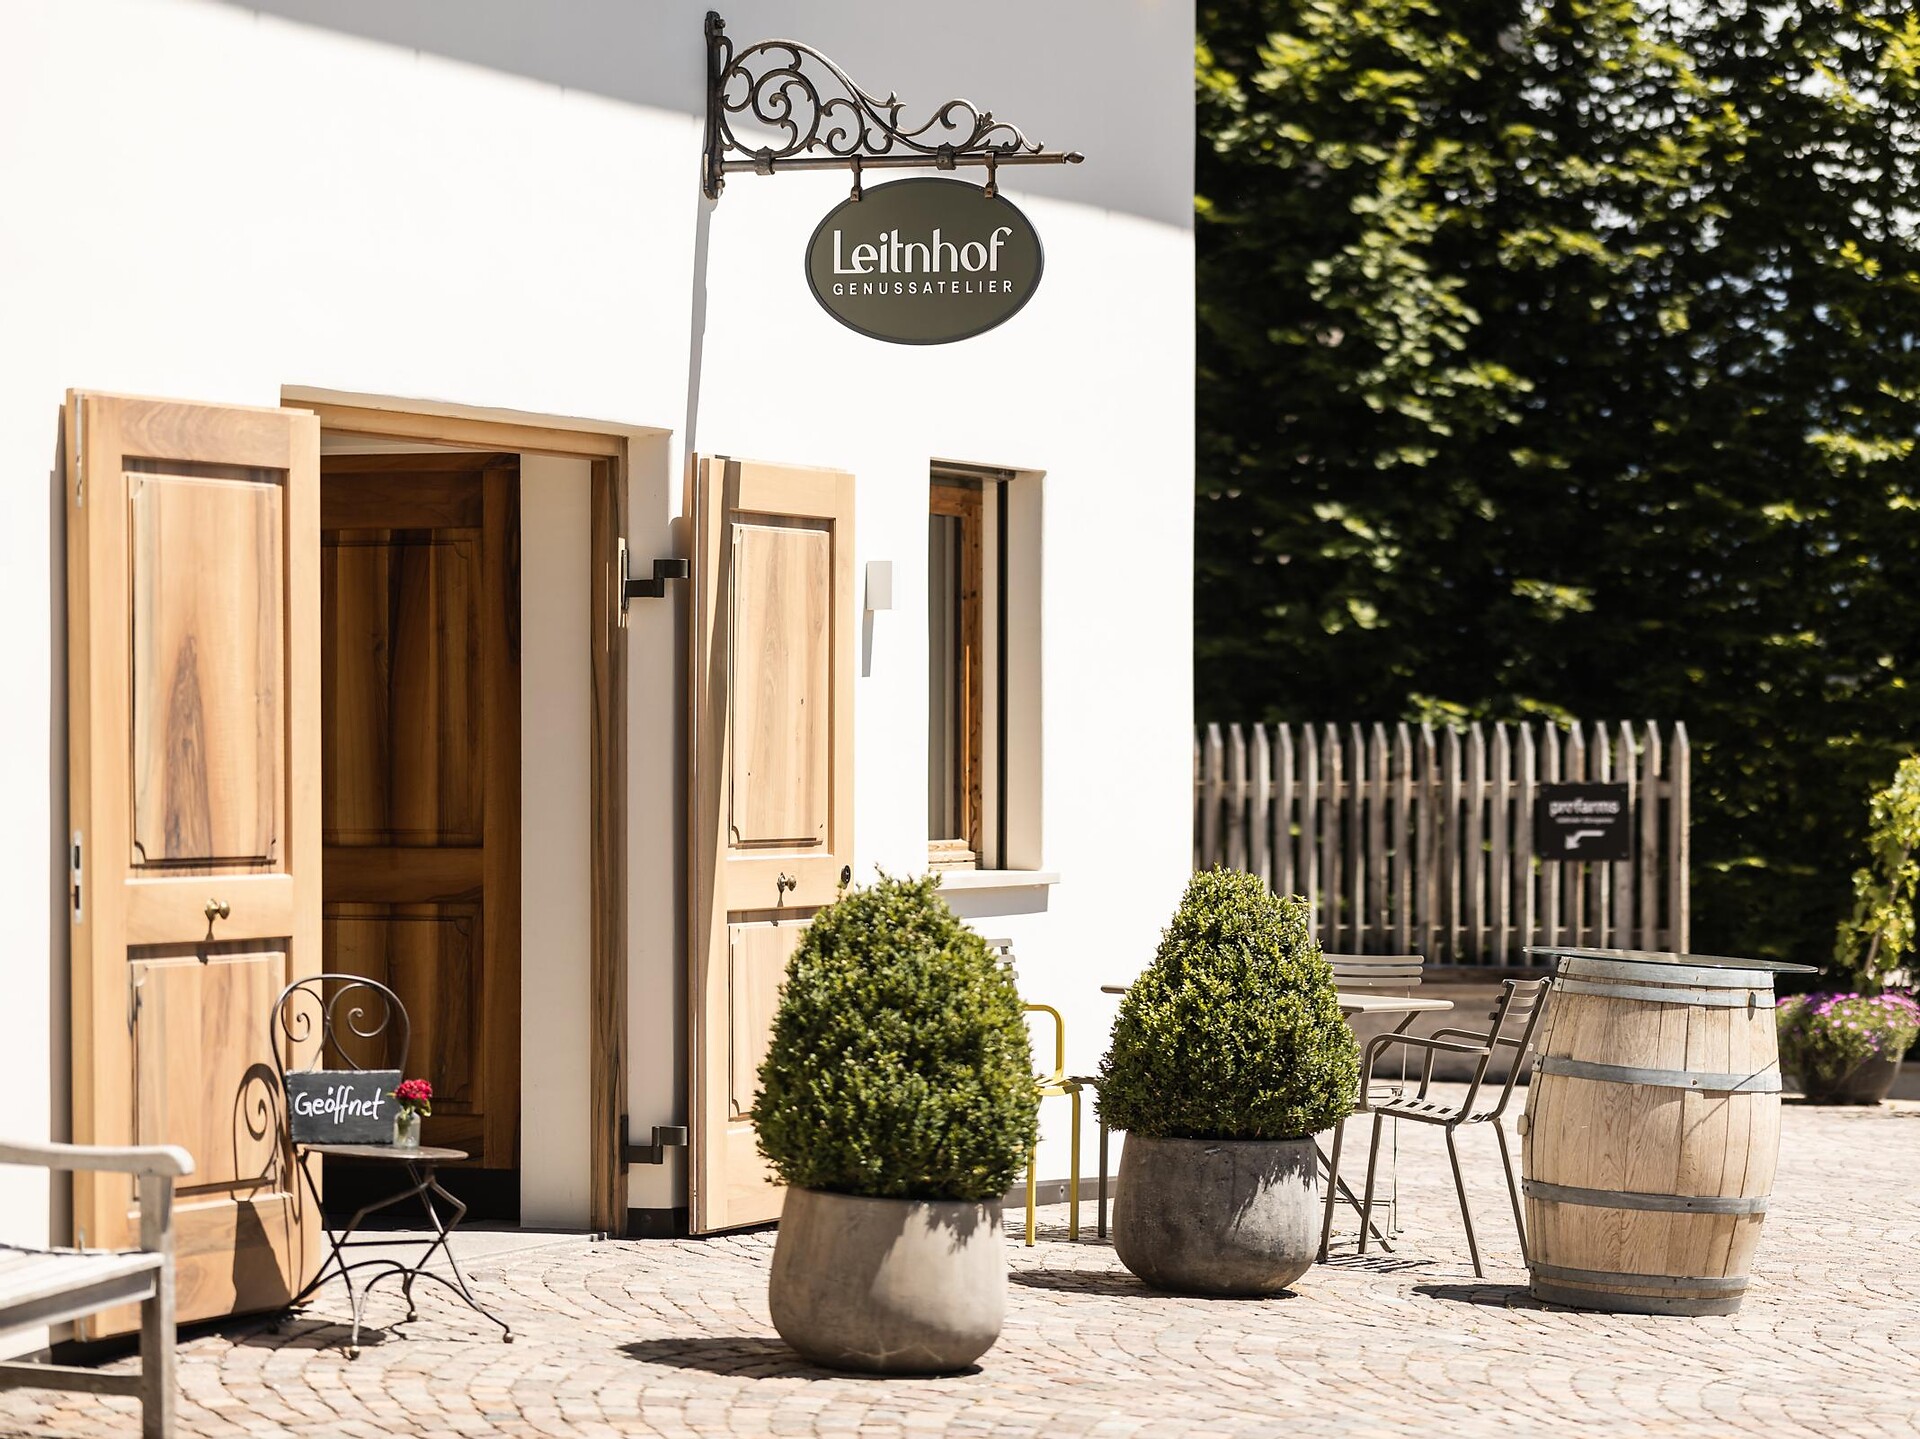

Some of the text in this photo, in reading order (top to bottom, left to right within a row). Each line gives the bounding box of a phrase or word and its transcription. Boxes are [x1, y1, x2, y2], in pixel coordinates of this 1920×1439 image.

[833, 226, 1013, 274] Leitnhof
[832, 280, 1013, 296] GENUSSATELIER
[294, 1085, 385, 1124] Geöffnet
